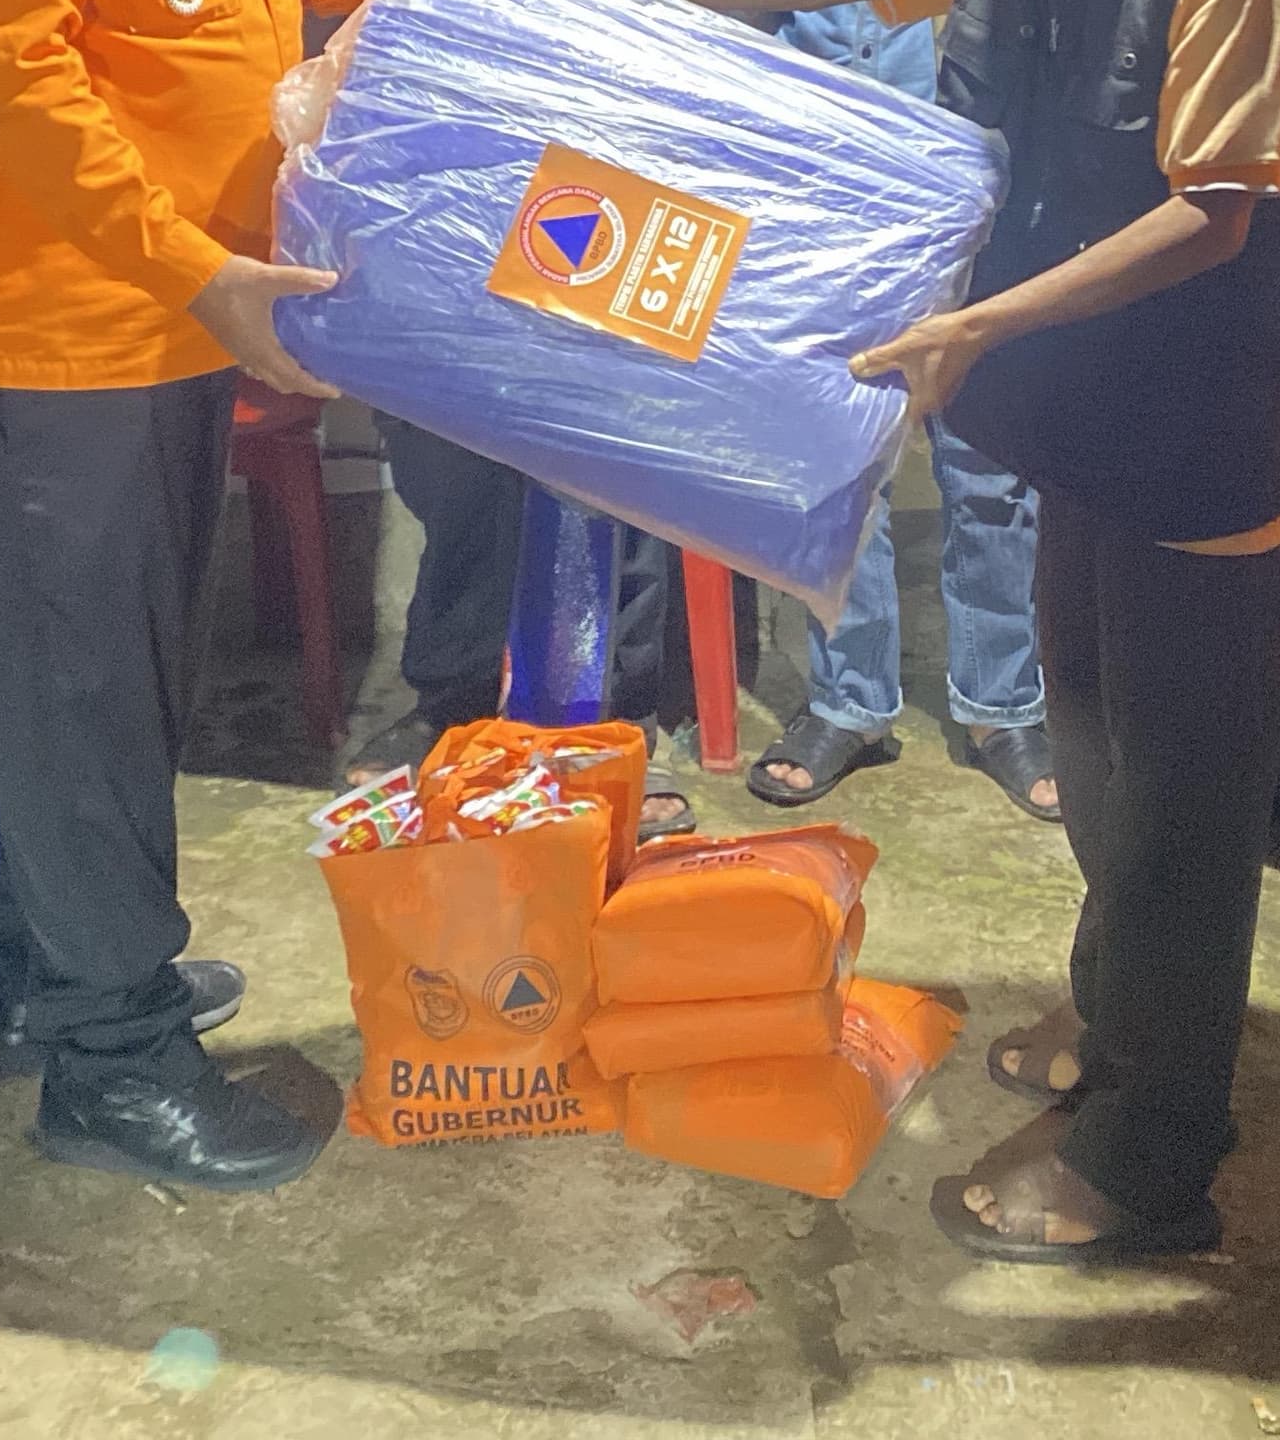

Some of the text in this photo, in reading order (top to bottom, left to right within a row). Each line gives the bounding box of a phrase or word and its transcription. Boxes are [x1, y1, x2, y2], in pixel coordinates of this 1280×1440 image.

[588, 230, 608, 261] BPBD
[663, 215, 699, 251] 12
[650, 253, 684, 285] X
[639, 287, 669, 313] 6
[392, 1097, 583, 1137] GUBERNUR
